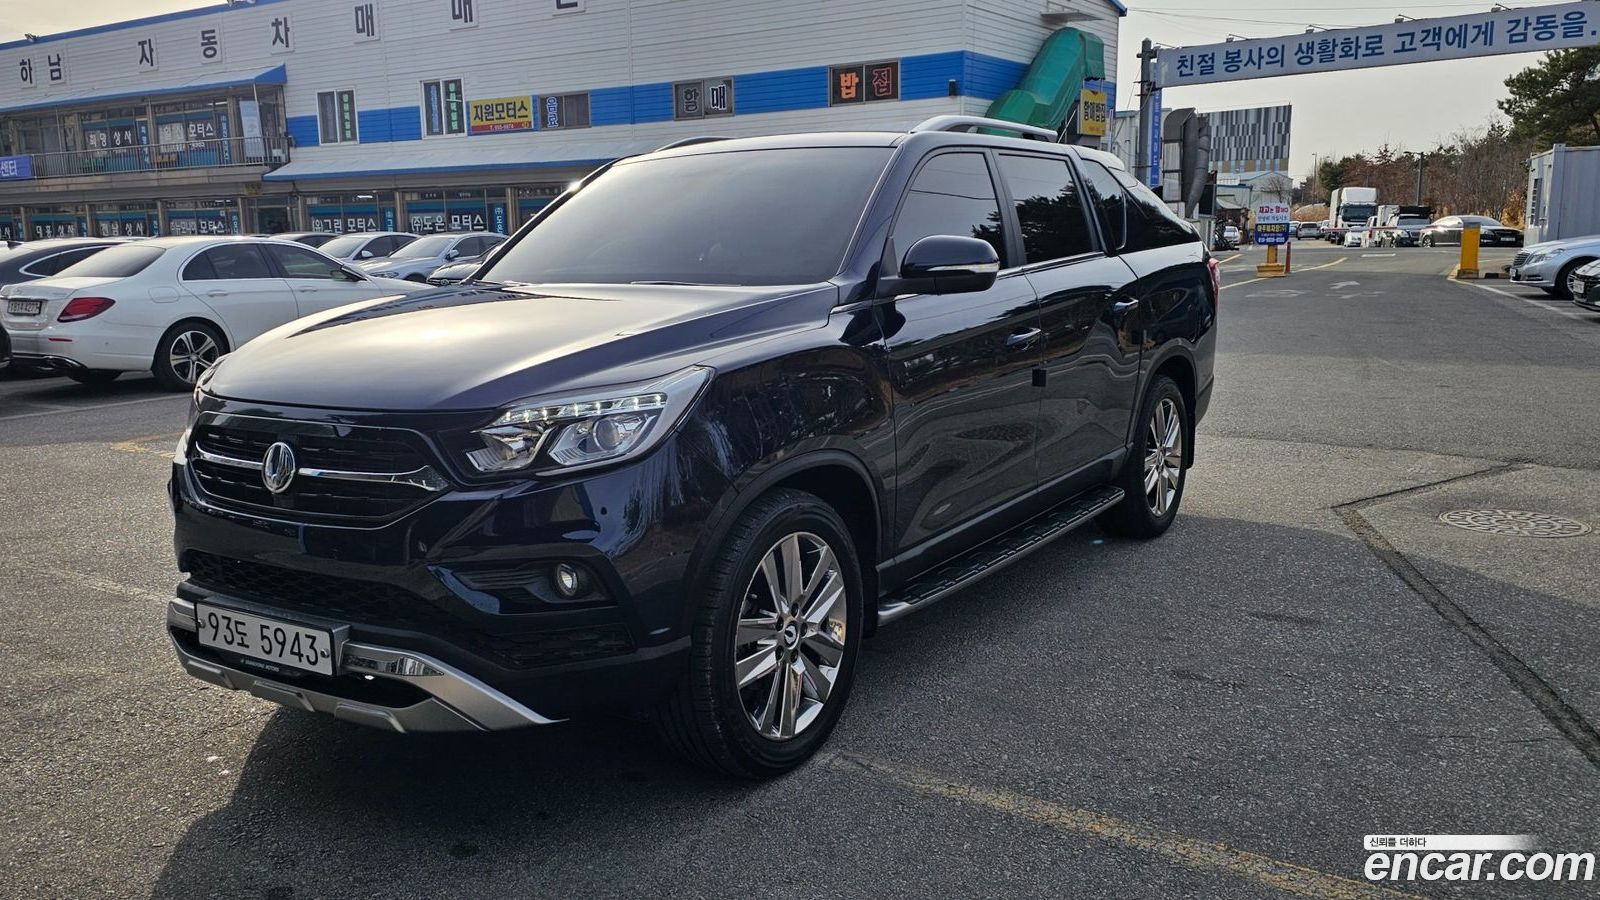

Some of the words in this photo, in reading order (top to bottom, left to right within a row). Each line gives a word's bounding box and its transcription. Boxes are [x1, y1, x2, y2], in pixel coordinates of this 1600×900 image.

[1177, 52, 1215, 77] 친절
[1222, 44, 1285, 73] 봉사의
[1294, 34, 1385, 66] 생활화로
[1393, 20, 1495, 54] 고객에게
[1506, 10, 1597, 44] 감동을.
[19, 54, 63, 84] 하남
[473, 100, 529, 123] 지원모터스
[113, 130, 132, 146] 상사
[188, 121, 215, 138] 모터스
[125, 222, 144, 236] 상사
[200, 220, 225, 235] 모터스
[347, 217, 377, 233] 모터스
[451, 214, 485, 231] 모터스
[207, 611, 250, 649] 93도
[259, 623, 319, 666] 5943
